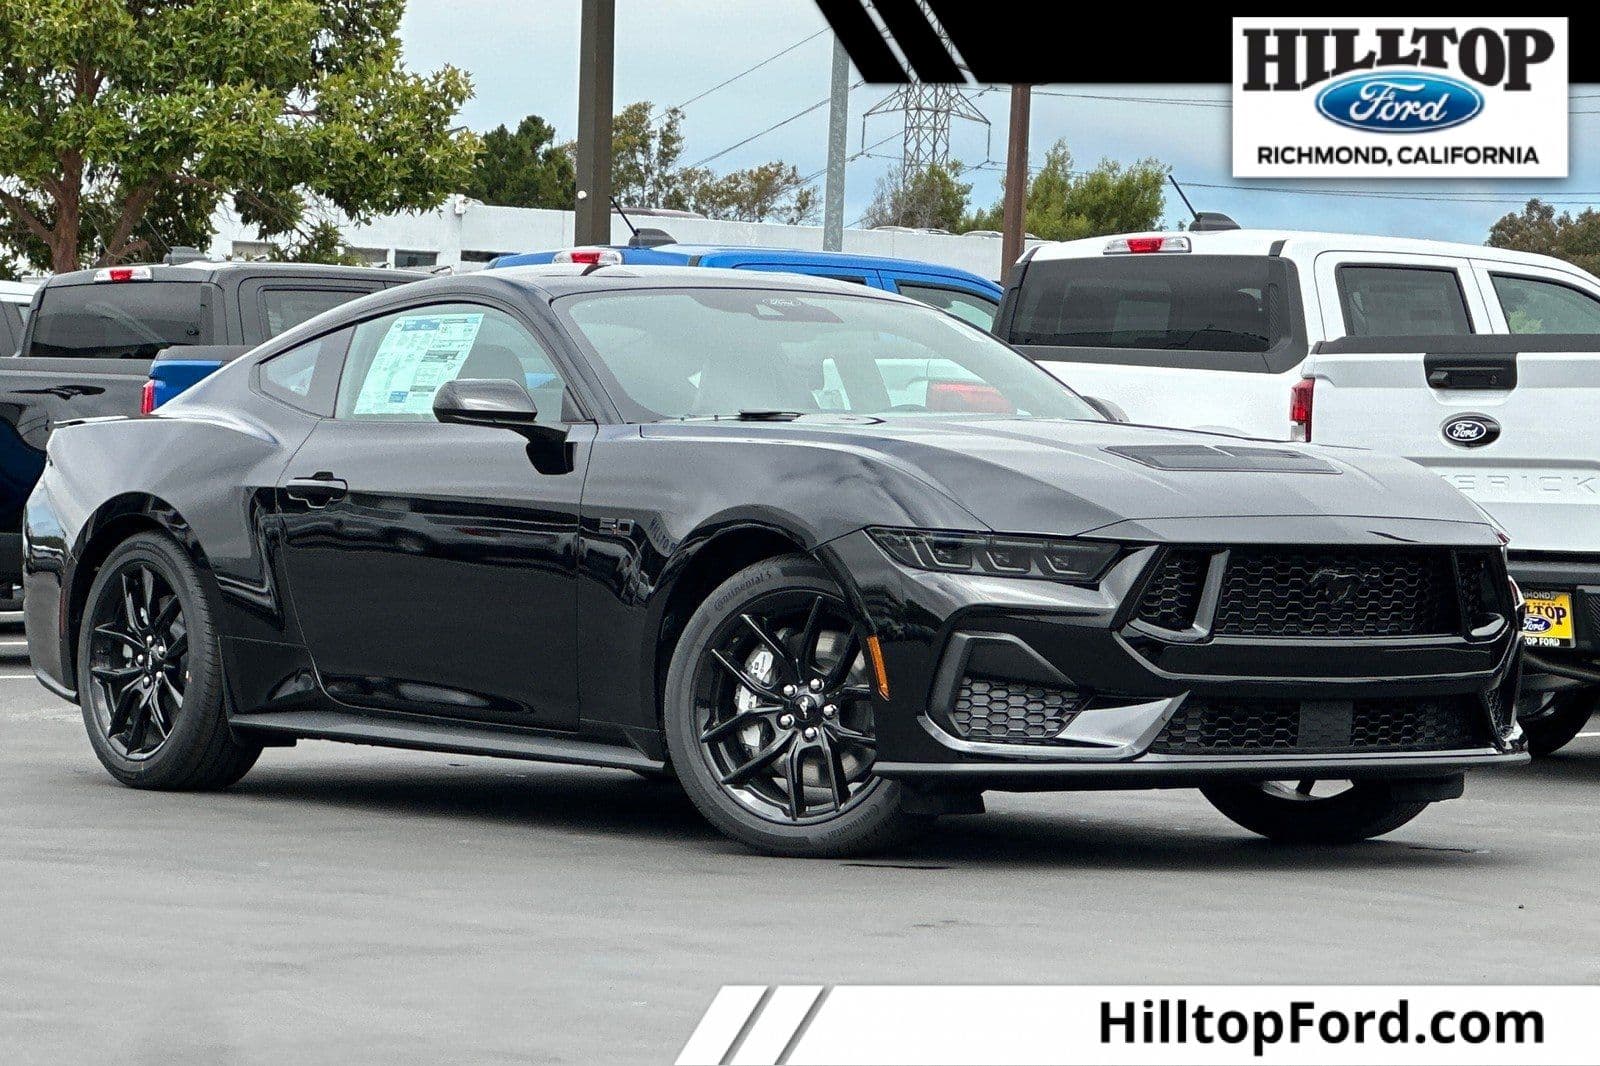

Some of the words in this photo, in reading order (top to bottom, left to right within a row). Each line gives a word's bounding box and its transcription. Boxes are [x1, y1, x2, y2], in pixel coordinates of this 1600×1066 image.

[1452, 422, 1479, 438] Ford
[1440, 474, 1597, 494] ERICK
[1523, 617, 1546, 631] Ford
[1539, 637, 1560, 647] FORD
